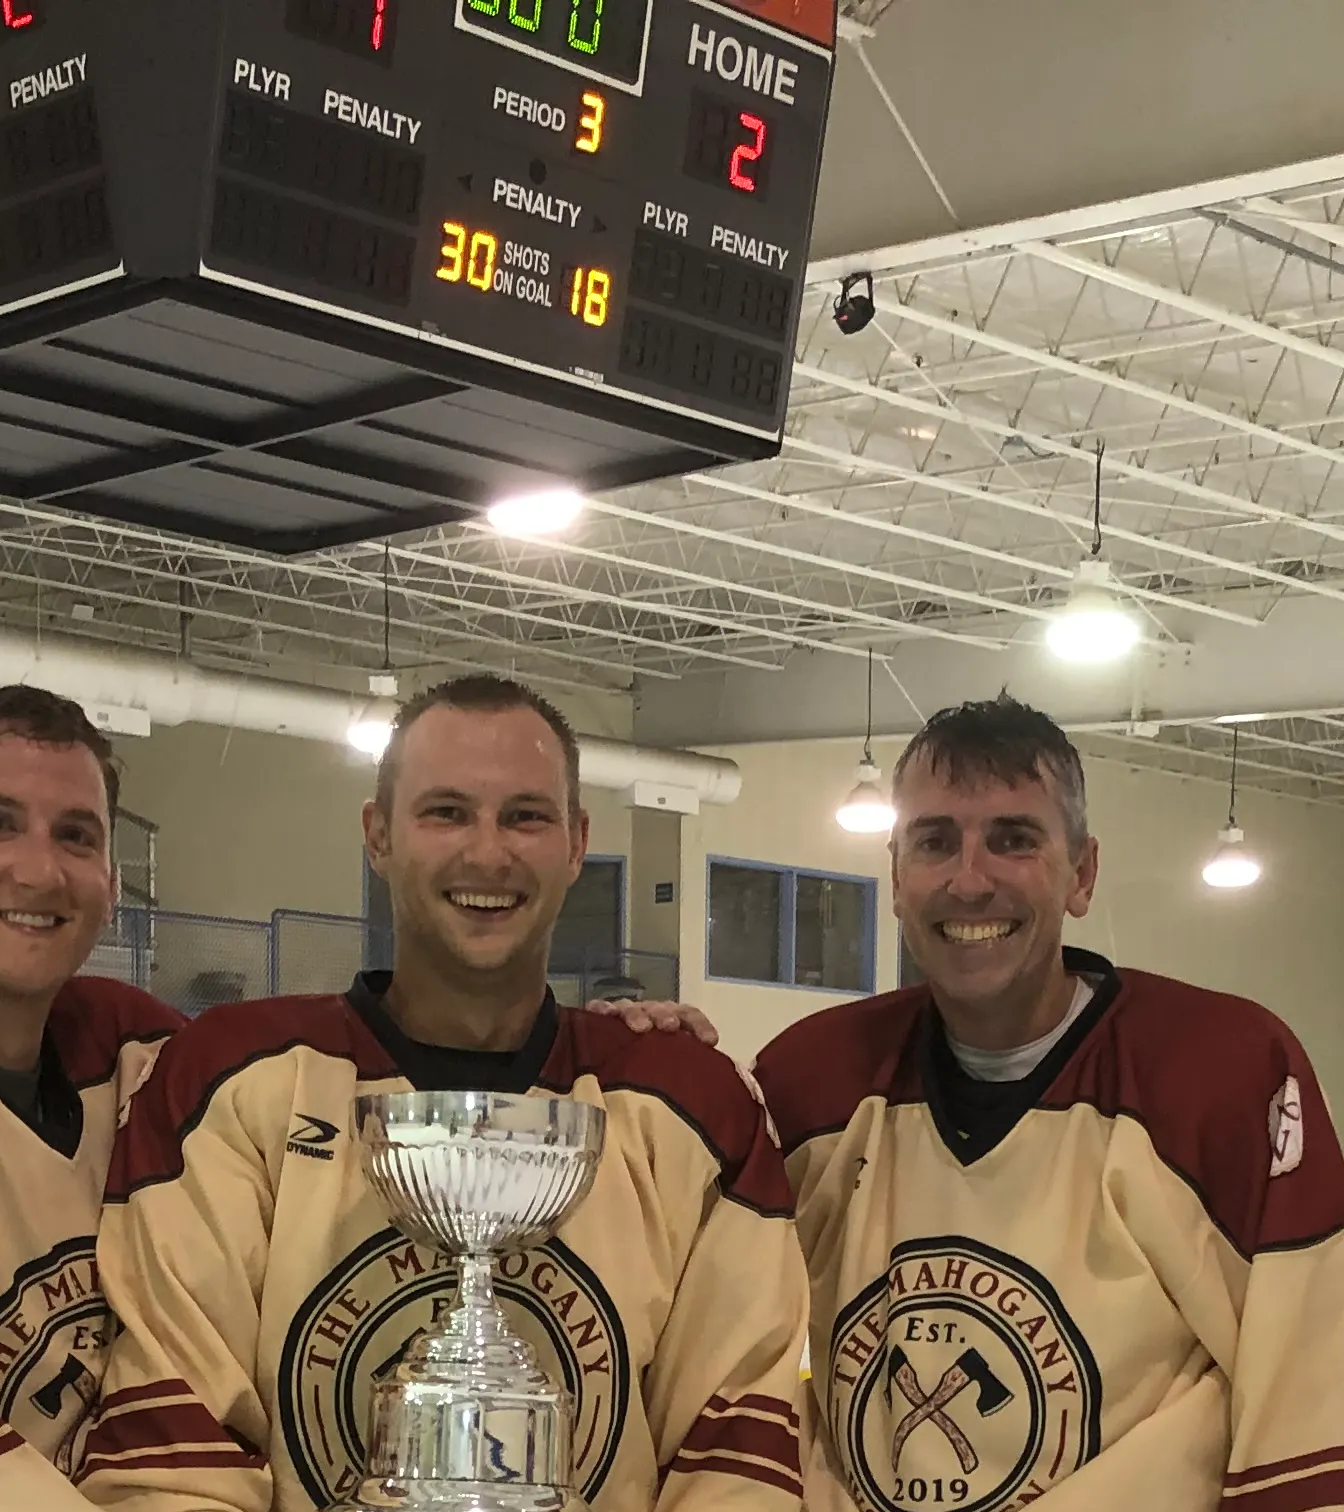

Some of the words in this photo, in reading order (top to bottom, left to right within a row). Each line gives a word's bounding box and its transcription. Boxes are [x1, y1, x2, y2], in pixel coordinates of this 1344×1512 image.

[10, 53, 88, 108] PENALTY
[687, 23, 798, 105] HOME
[234, 58, 291, 101] PLYR
[323, 88, 421, 145] PENALTY
[492, 86, 565, 133] PERIOD
[576, 92, 605, 154] 3
[728, 112, 764, 192] 2
[492, 178, 581, 228] PENALTY
[642, 201, 688, 238] PLYR
[710, 225, 789, 272] PENALTY
[436, 222, 496, 291] 30
[493, 268, 514, 296] ON
[516, 276, 553, 308] GOAL
[504, 241, 550, 275] SHOTS
[571, 267, 610, 326] 18
[286, 1141, 335, 1160] DYNAMIC
[306, 1288, 371, 1371] THE
[887, 1257, 1077, 1395] MAHOGANY
[892, 1478, 969, 1503] 2019
